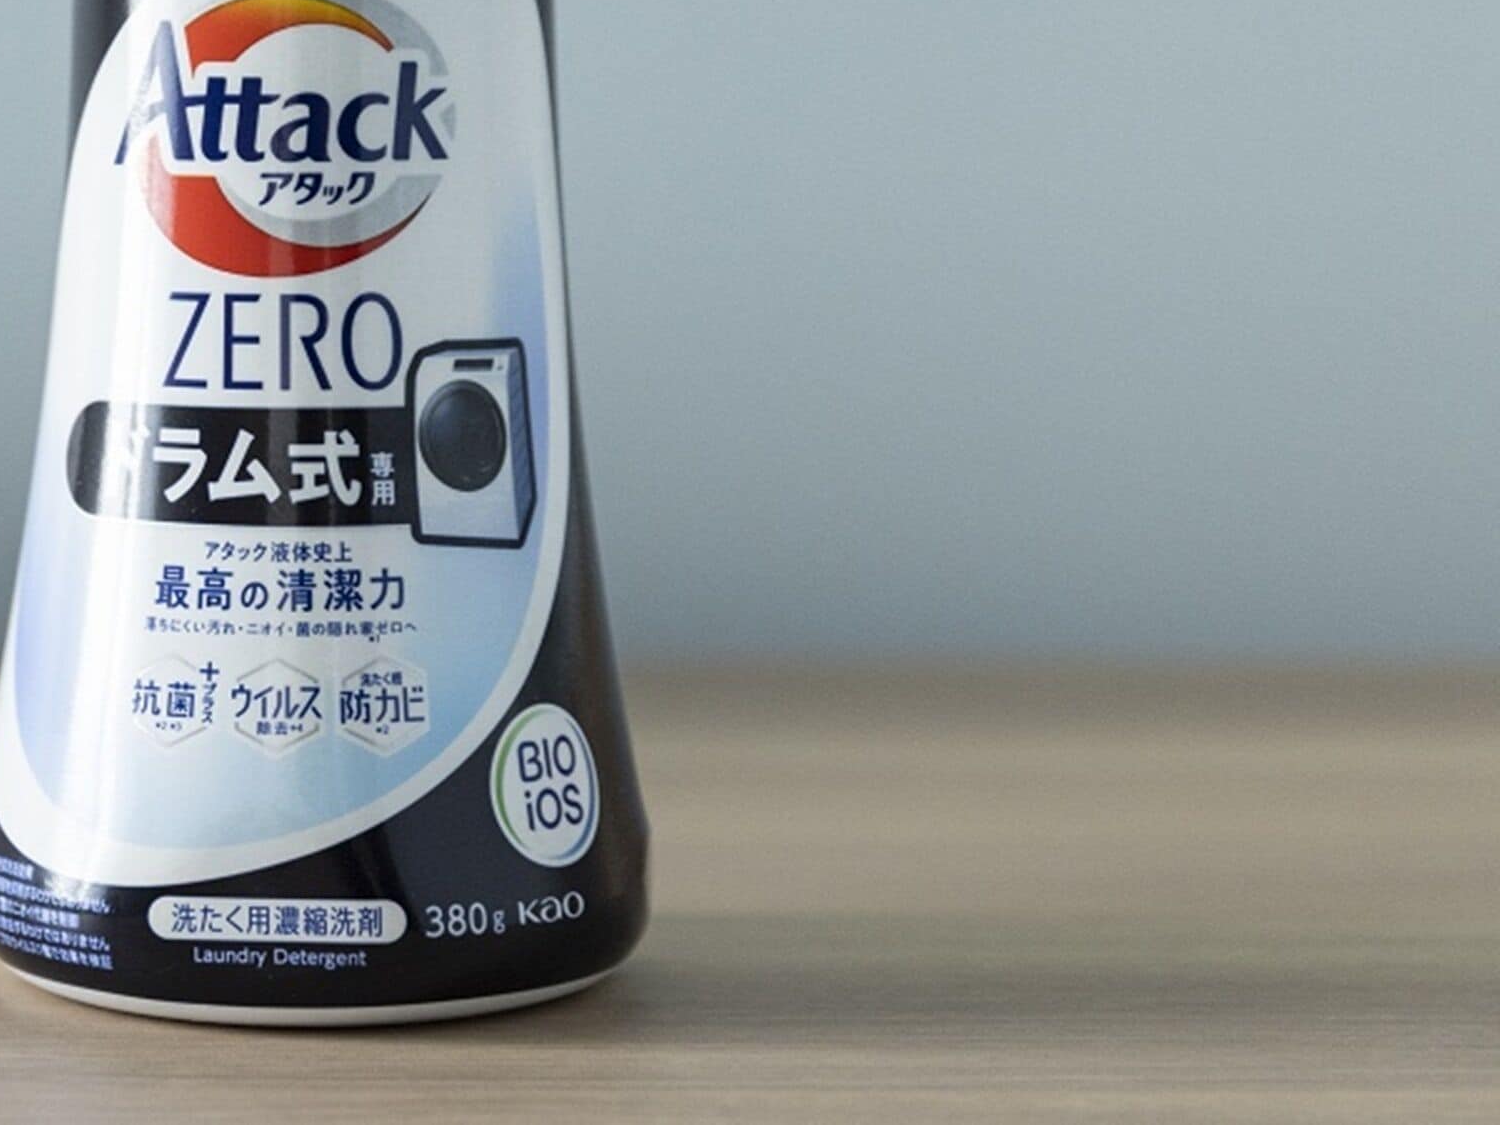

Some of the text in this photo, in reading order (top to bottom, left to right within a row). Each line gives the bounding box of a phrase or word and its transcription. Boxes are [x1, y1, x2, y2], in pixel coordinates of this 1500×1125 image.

[114, 20, 449, 165] Attack
[259, 172, 375, 206] アタック
[163, 292, 402, 391] ZERO
[155, 565, 405, 612] 最高の清潔力
[133, 679, 196, 717] 抗菌
[231, 684, 322, 719] ウイルス
[340, 686, 425, 724] 防カビ
[518, 735, 577, 783] BIO
[524, 784, 584, 831] iOS
[171, 903, 384, 938] 洗たく用濃縮洗剤
[193, 947, 367, 968] Laundry Detergent
